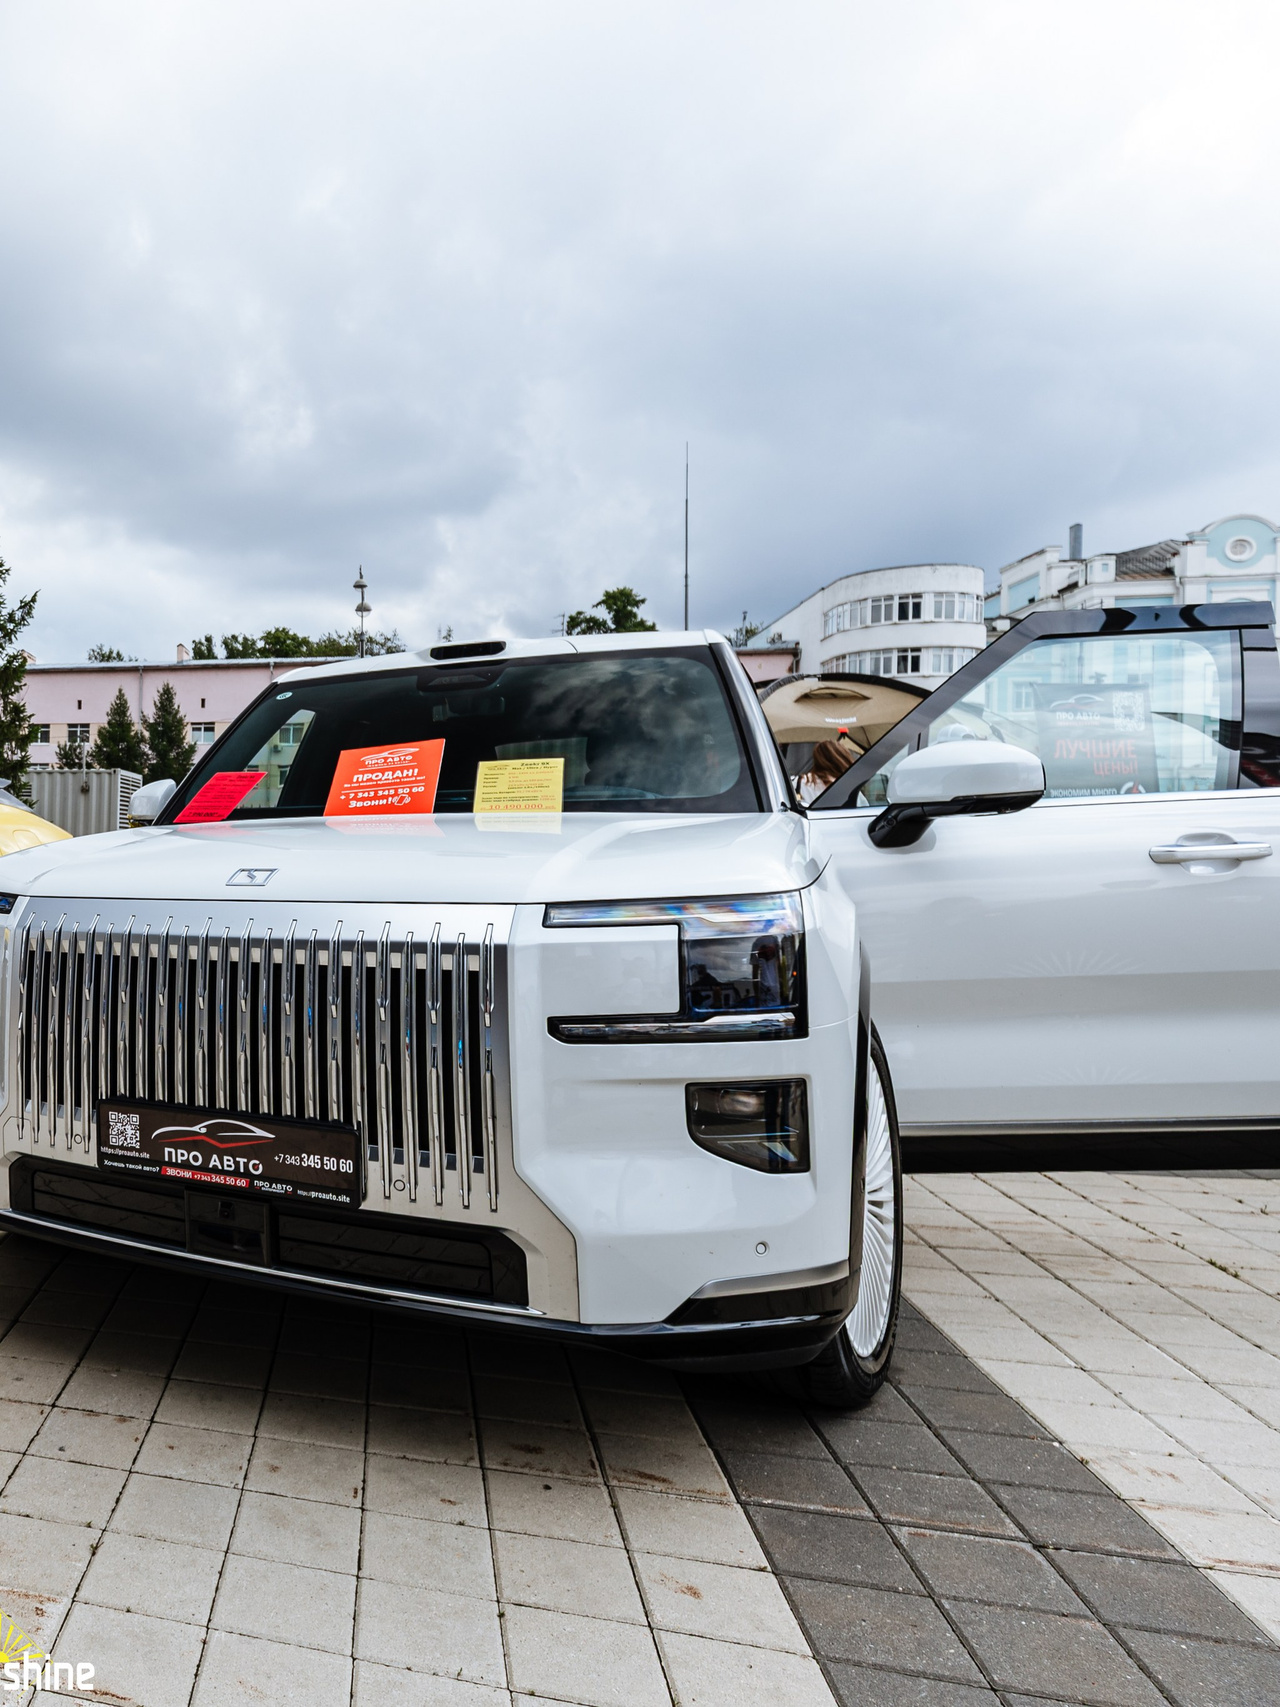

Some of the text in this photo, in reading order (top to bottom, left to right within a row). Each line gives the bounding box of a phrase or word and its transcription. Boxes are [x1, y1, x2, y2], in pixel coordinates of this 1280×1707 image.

[1056, 711, 1100, 720] ПРО АВТО
[1054, 739, 1137, 759] ЛУЧШИЕ
[387, 755, 413, 763] АВТО
[353, 768, 419, 783] ПРОДАН!
[1093, 759, 1138, 778] ЦЕНЫ!
[357, 791, 375, 799] 343
[377, 789, 395, 797] 345
[1050, 788, 1091, 798] ЭКОНОМИМ
[348, 797, 392, 808] Звони!
[103, 1159, 160, 1173] Хочешь такой авто?
[164, 1147, 263, 1175] ПРО АВТО
[273, 1153, 354, 1174] +7 343 345 50 60
[166, 1168, 192, 1179] ЗВОНИ
[211, 1173, 225, 1184] 345
[225, 1176, 235, 1185] 50
[236, 1178, 247, 1187] 60
[254, 1180, 293, 1192] ПРО АВТО
